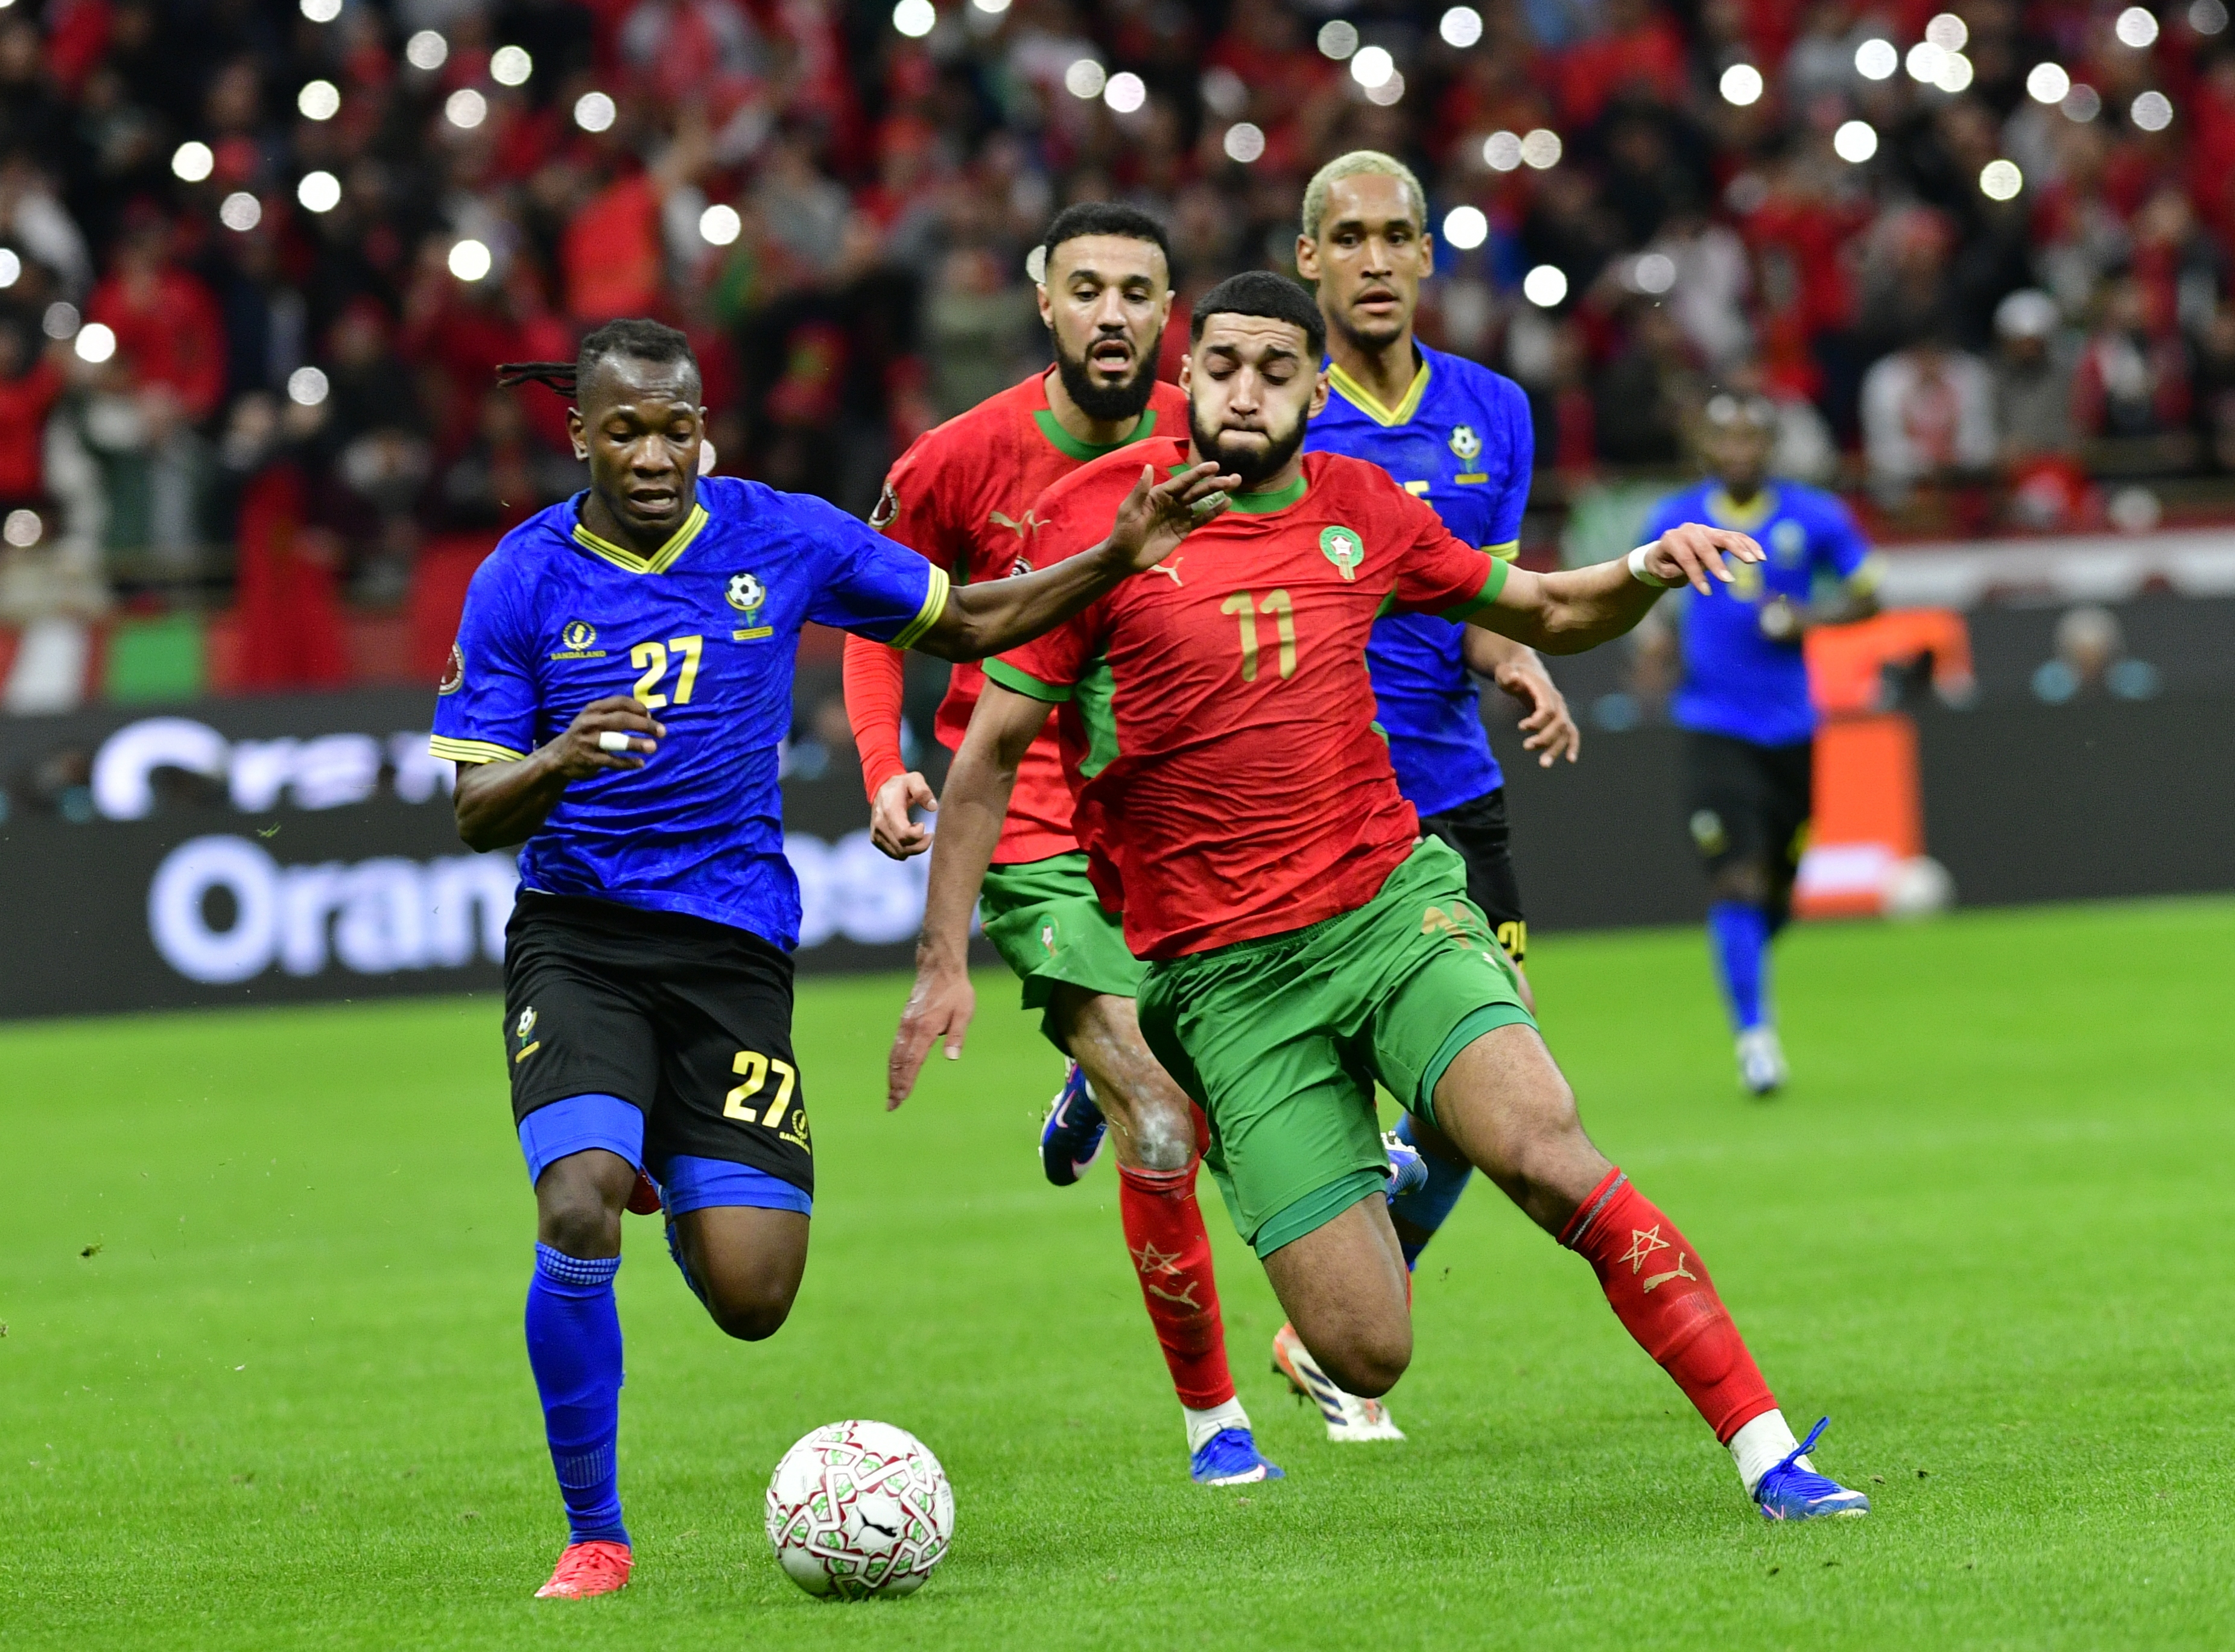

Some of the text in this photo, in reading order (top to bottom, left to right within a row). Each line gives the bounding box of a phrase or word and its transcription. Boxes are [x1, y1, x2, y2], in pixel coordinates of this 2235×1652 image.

[551, 651, 606, 660] SANDALAND
[630, 635, 703, 708] 27
[1220, 589, 1296, 682] 11
[723, 1051, 795, 1128] 27
